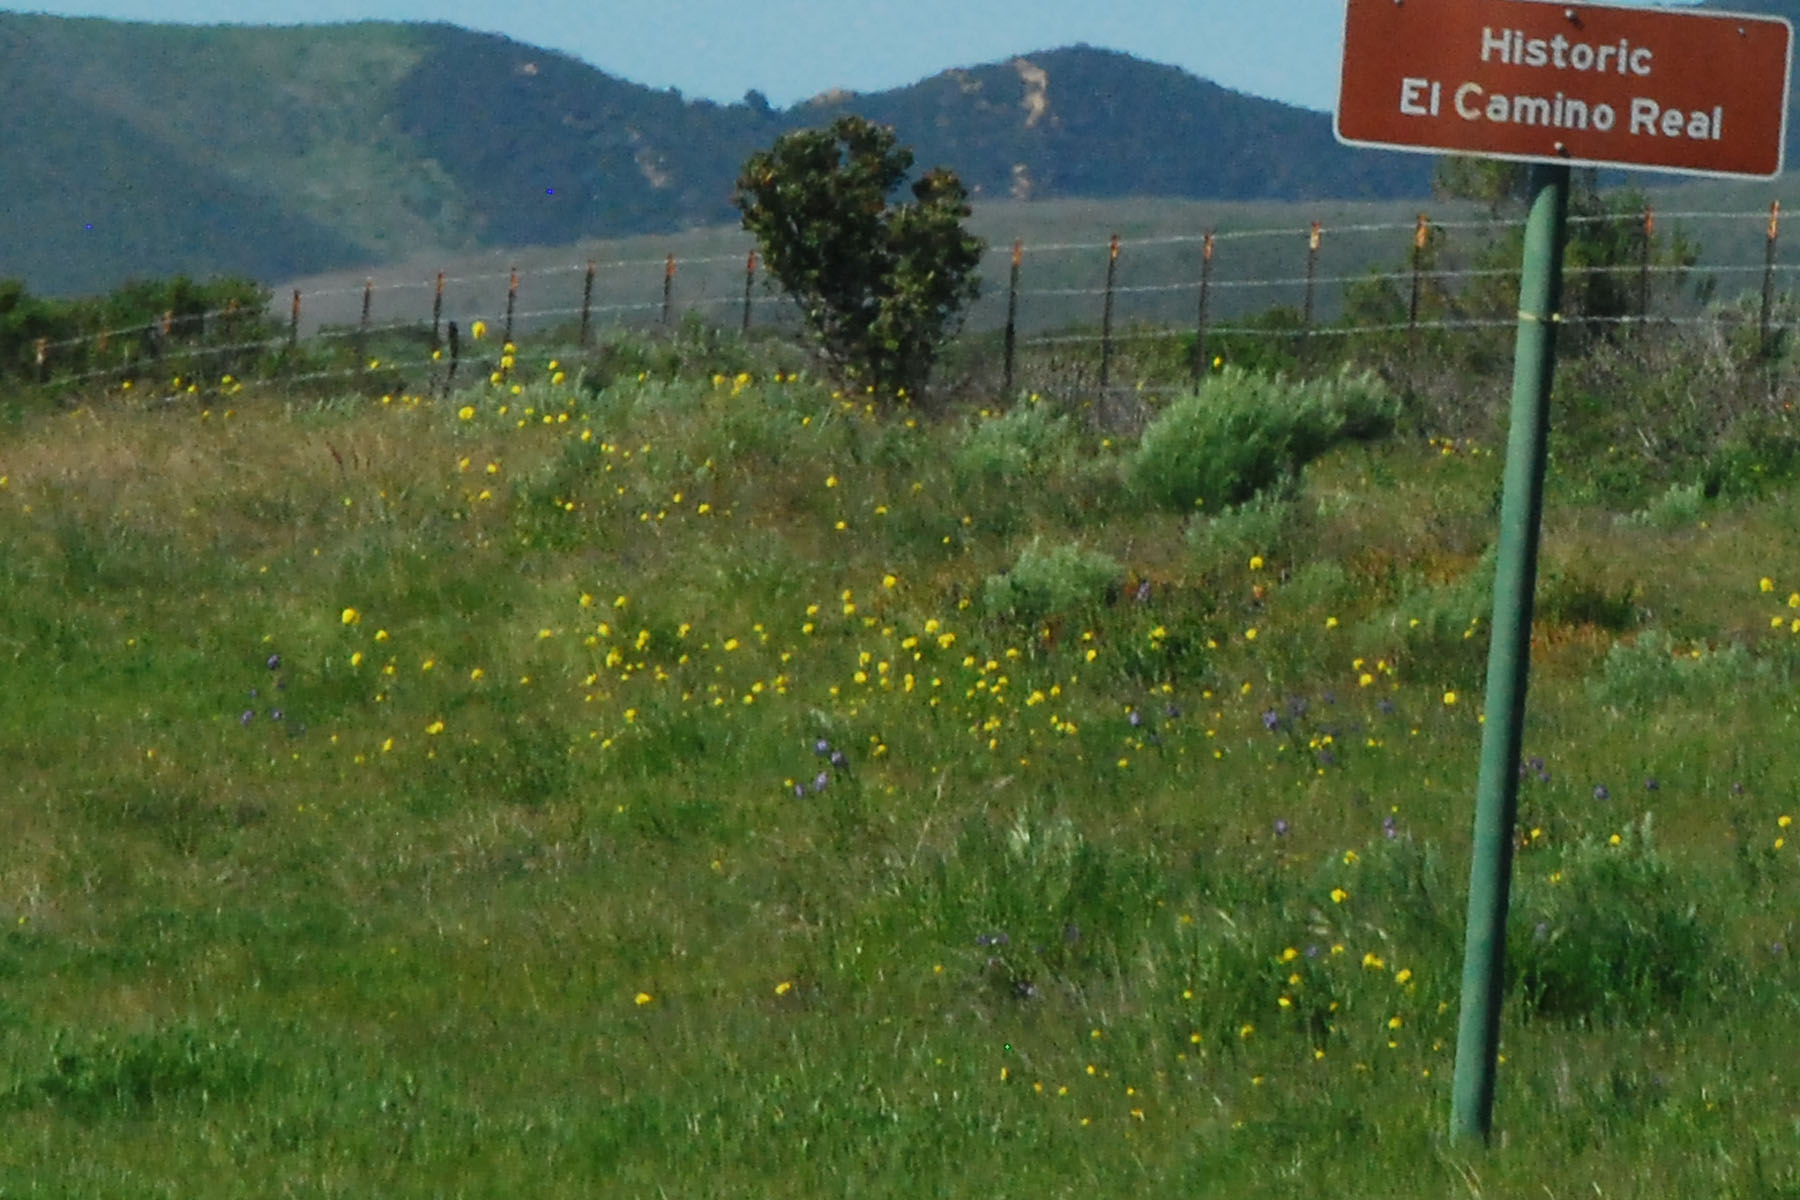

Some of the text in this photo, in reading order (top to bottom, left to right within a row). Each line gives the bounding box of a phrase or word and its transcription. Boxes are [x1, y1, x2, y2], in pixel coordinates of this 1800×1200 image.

[1480, 27, 1653, 76] Historic
[1399, 77, 1723, 141] El Camino Real
